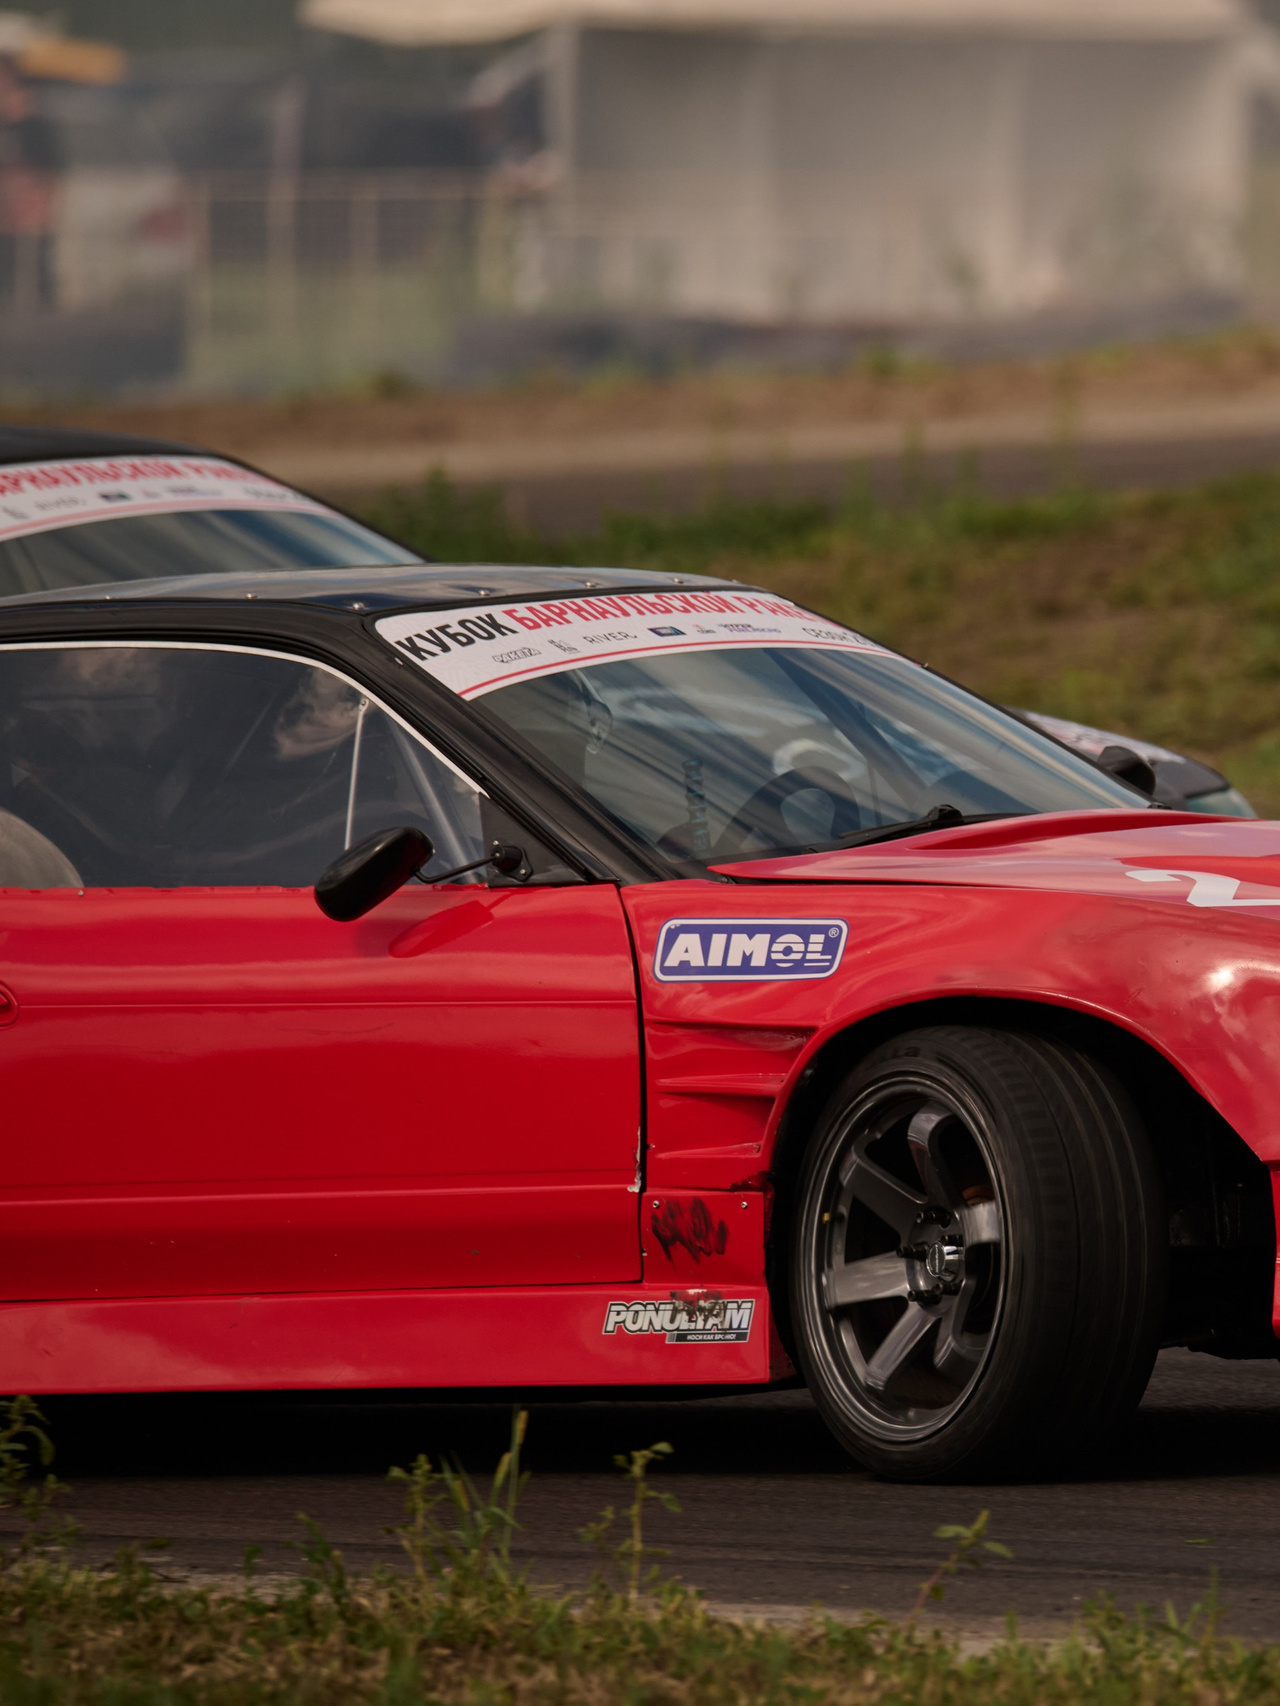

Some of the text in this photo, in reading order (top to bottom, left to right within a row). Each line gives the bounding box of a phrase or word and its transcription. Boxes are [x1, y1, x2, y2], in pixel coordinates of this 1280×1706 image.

[394, 613, 519, 661] КУБОК
[502, 591, 747, 630] БАРНАУЛЬСКОЙ
[582, 630, 638, 646] RIVER
[663, 932, 833, 968] AIMOL
